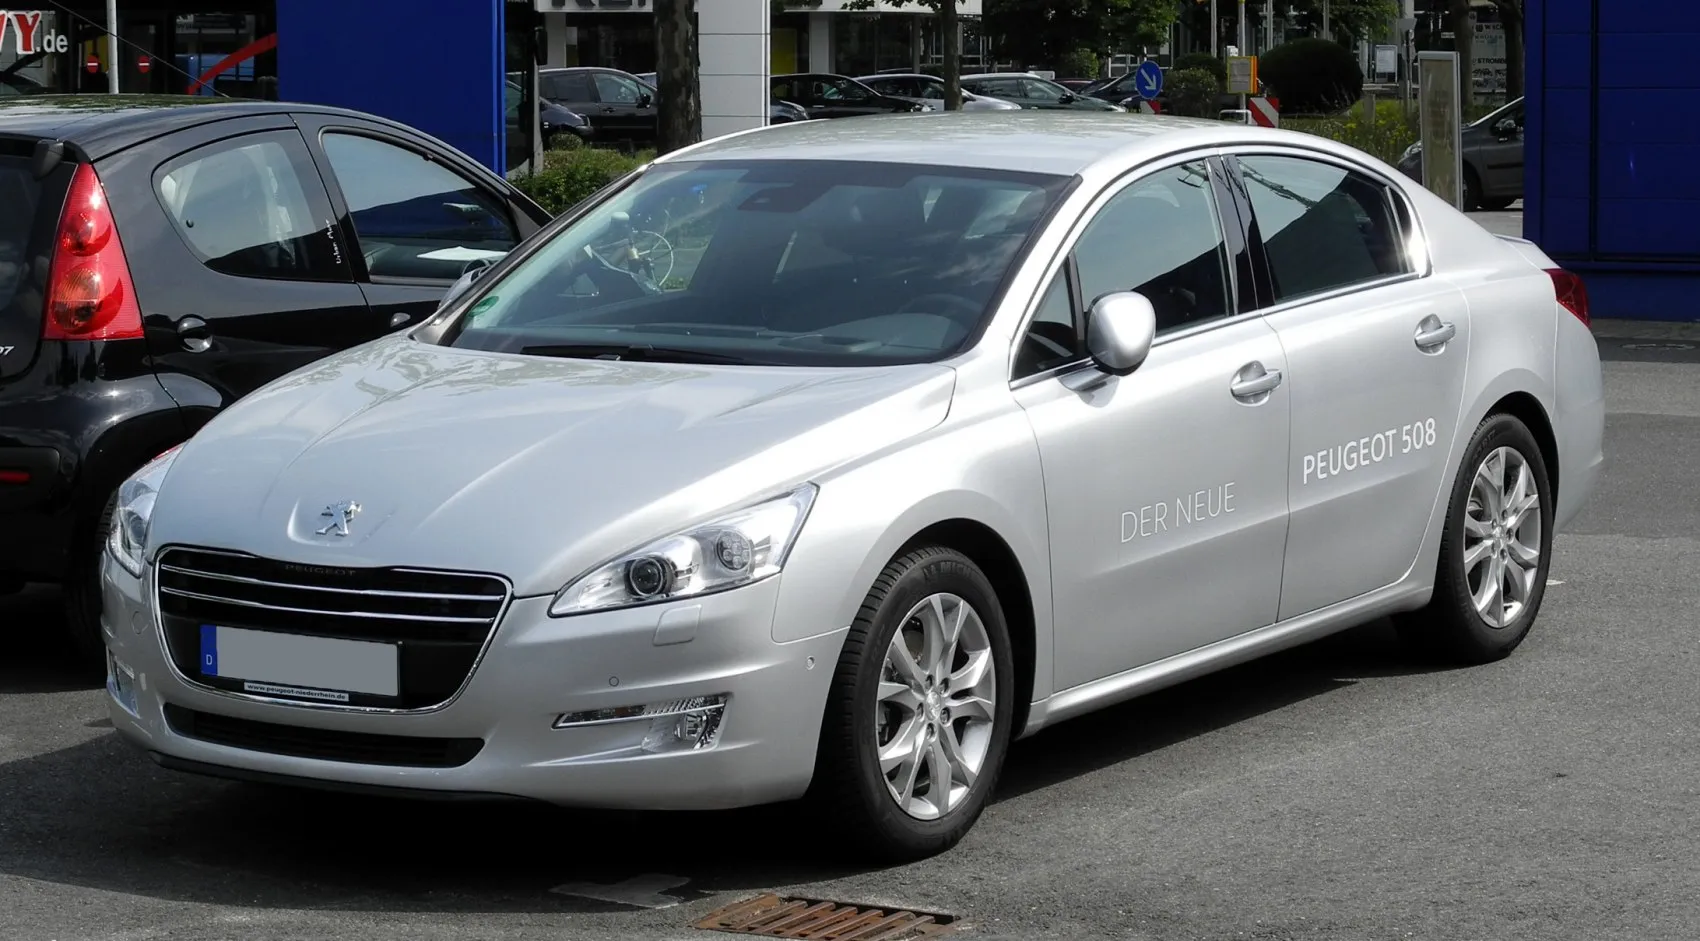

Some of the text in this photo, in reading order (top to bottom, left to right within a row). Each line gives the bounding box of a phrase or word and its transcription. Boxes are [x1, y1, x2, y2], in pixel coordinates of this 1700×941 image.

[1303, 417, 1436, 484] PEUGEOT 508
[1120, 482, 1236, 543] DER NEUE
[285, 564, 356, 576] PEUGEOT
[205, 654, 213, 666] D
[247, 684, 346, 700] www.peugeot-niederrhein.de
